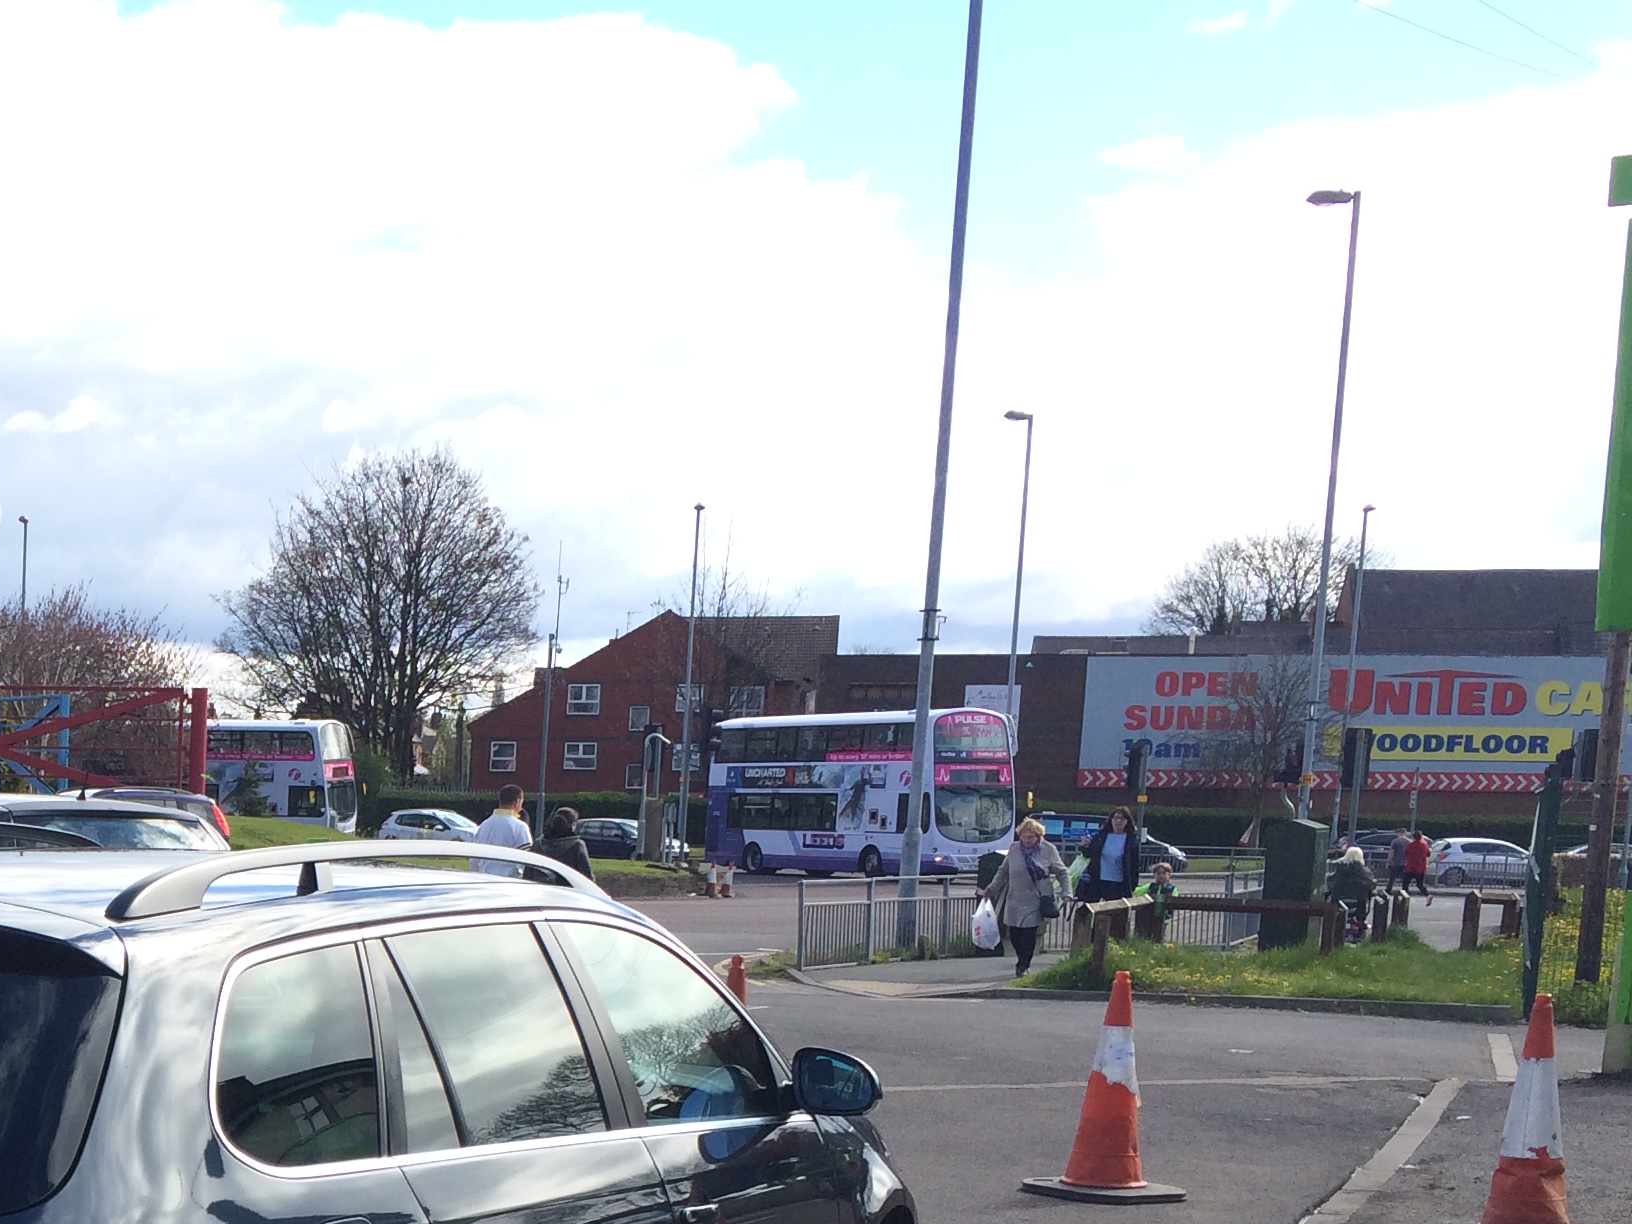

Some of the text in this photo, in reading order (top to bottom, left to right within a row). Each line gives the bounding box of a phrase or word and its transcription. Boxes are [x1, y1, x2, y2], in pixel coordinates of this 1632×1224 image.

[1155, 671, 1259, 697] OPEN
[1328, 668, 1528, 716] UNITED
[954, 715, 988, 724] PULSE
[1368, 731, 1550, 755] OODFLOOR
